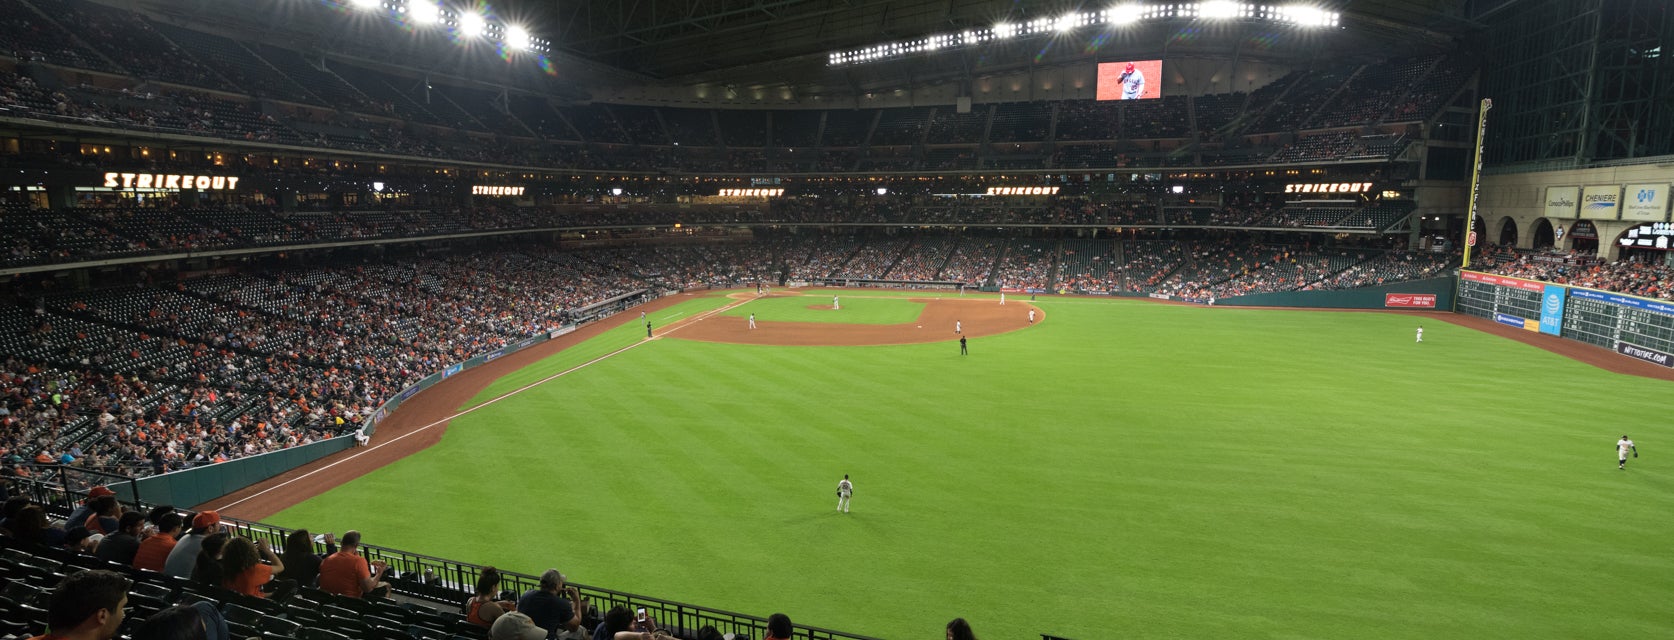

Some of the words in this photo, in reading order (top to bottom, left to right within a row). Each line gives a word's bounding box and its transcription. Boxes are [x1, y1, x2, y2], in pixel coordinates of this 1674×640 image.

[103, 172, 239, 190] STRIKEOUT
[472, 185, 525, 196] STRIKEOUT
[718, 188, 785, 197] STRIKEOUT
[986, 186, 1060, 195] STRIKEOUT
[1284, 182, 1373, 193] STRIKEOUT
[1585, 194, 1617, 202] CHENIERE
[1542, 316, 1560, 327] AT&T
[1623, 345, 1668, 365] NITTOTIRE.COM
